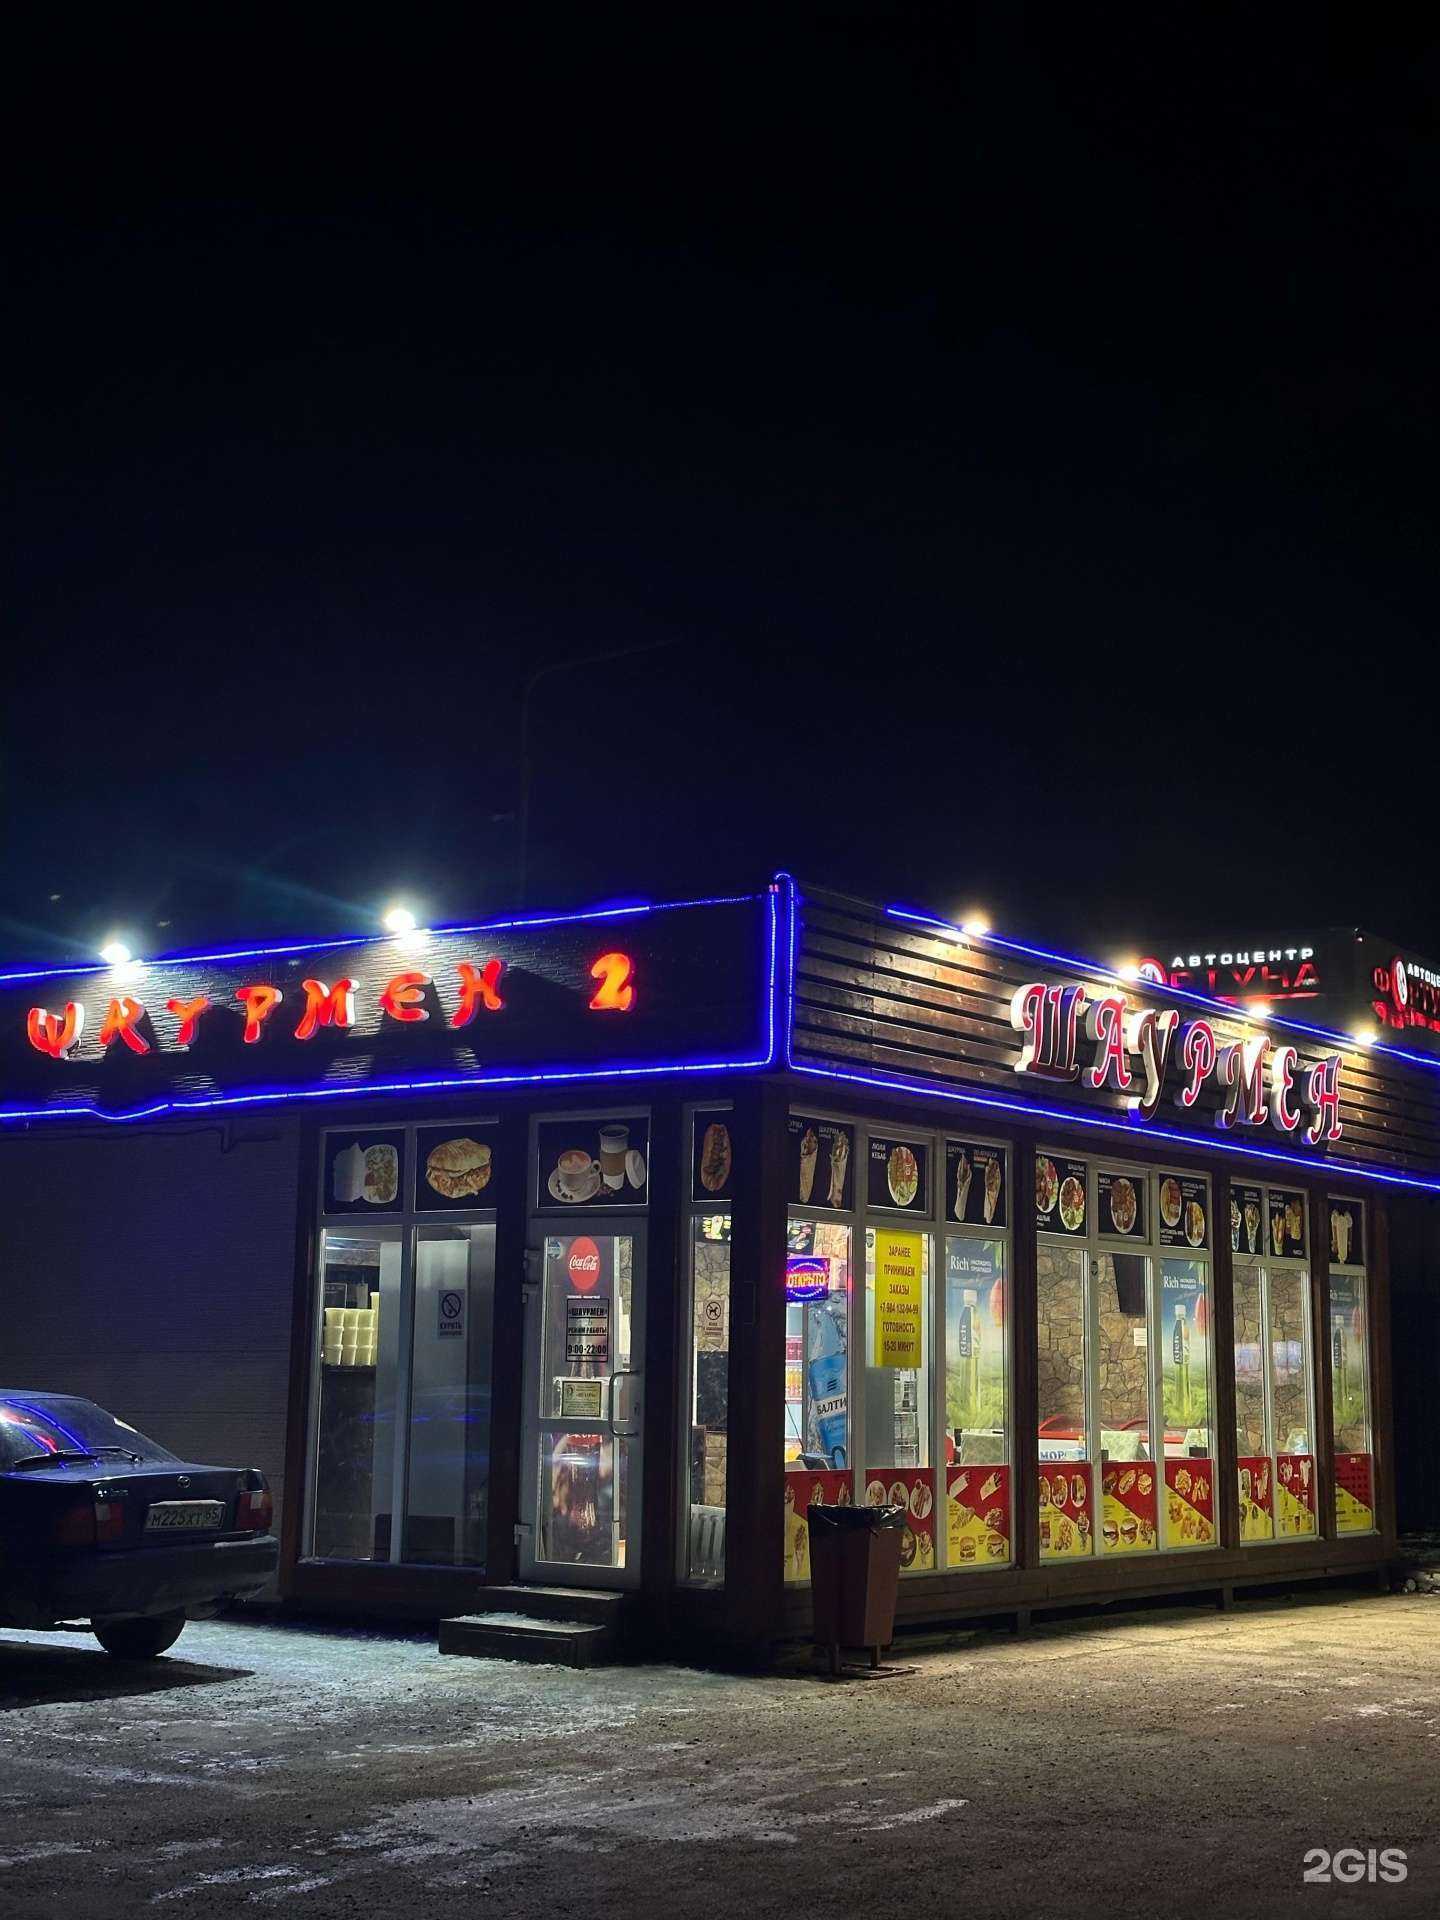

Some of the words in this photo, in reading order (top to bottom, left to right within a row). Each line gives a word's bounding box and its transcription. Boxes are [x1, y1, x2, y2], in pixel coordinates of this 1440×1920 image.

[1171, 947, 1315, 968] АВТОЦЕНТР
[27, 959, 506, 1060] ШАУРМЕН
[590, 952, 636, 1012] 2
[1011, 983, 1344, 1145] ШАУРМЕН
[888, 1246, 911, 1258] ЗАРАНЕЕ
[950, 1255, 969, 1271] Rich
[883, 1264, 916, 1277] ПРИНИМАЕМ
[1163, 1276, 1179, 1289] Rich
[888, 1284, 910, 1296] ЗАКАЗЫ
[882, 1321, 916, 1333] ГОТОВНОСТЬ
[897, 1341, 915, 1353] МИНУТ
